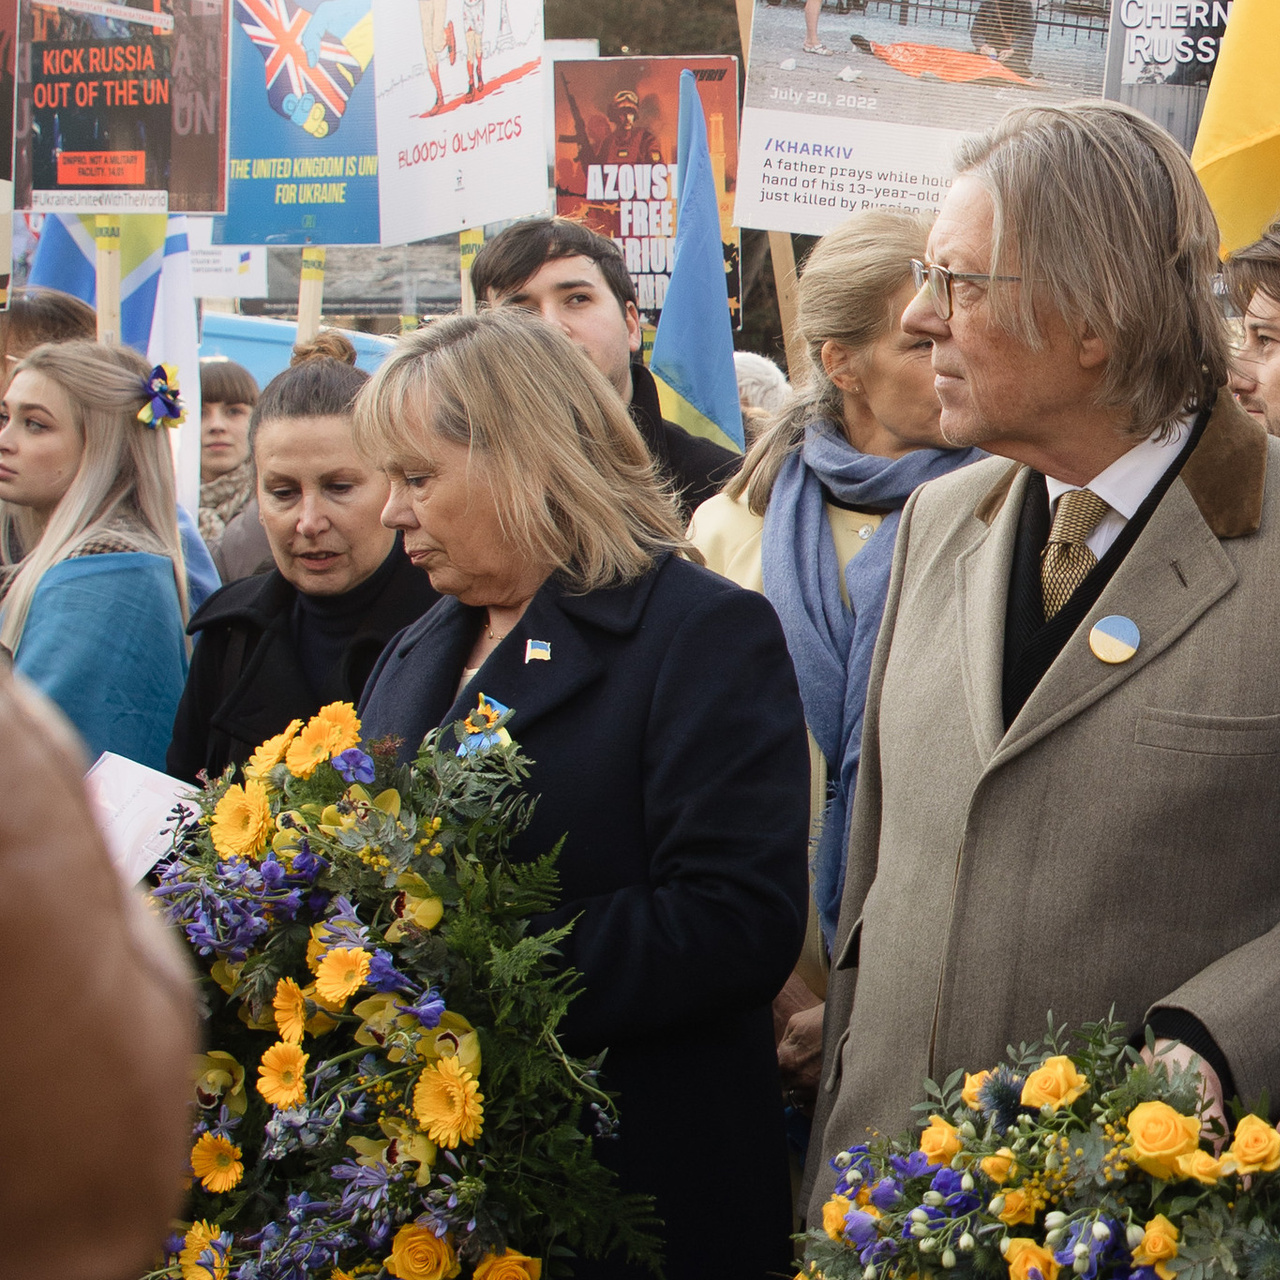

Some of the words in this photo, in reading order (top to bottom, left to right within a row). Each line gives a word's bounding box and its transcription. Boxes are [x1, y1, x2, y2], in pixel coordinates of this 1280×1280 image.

[43, 48, 85, 75] KICK
[89, 45, 155, 72] RUSSIA
[1129, 34, 1225, 63] RUSS
[34, 82, 71, 108] OUT
[75, 81, 99, 107] OF
[103, 80, 139, 106] THE
[143, 79, 169, 105] UN
[769, 87, 802, 103] July
[806, 91, 832, 107] 20,
[836, 94, 878, 110] 2022
[398, 136, 447, 169] BLOODY
[452, 115, 522, 153] OLYMPICS
[764, 138, 854, 159] /KHARKIV
[230, 158, 251, 179] THE
[252, 158, 292, 179] UNITED
[293, 156, 343, 178] KINGDOM
[345, 156, 357, 176] IS
[358, 155, 379, 176] UNI
[763, 158, 773, 169] A
[777, 158, 826, 174] father
[829, 166, 873, 181] prays
[877, 170, 918, 185] while
[275, 184, 297, 204] FOR
[299, 182, 347, 204] UKRAINE
[759, 188, 790, 203] just
[793, 190, 836, 207] killed
[840, 196, 857, 211] by
[761, 173, 798, 188] hand
[801, 178, 818, 190] of
[821, 179, 845, 192] his
[848, 182, 940, 202] 13-year-old
[620, 200, 674, 236] FREE
